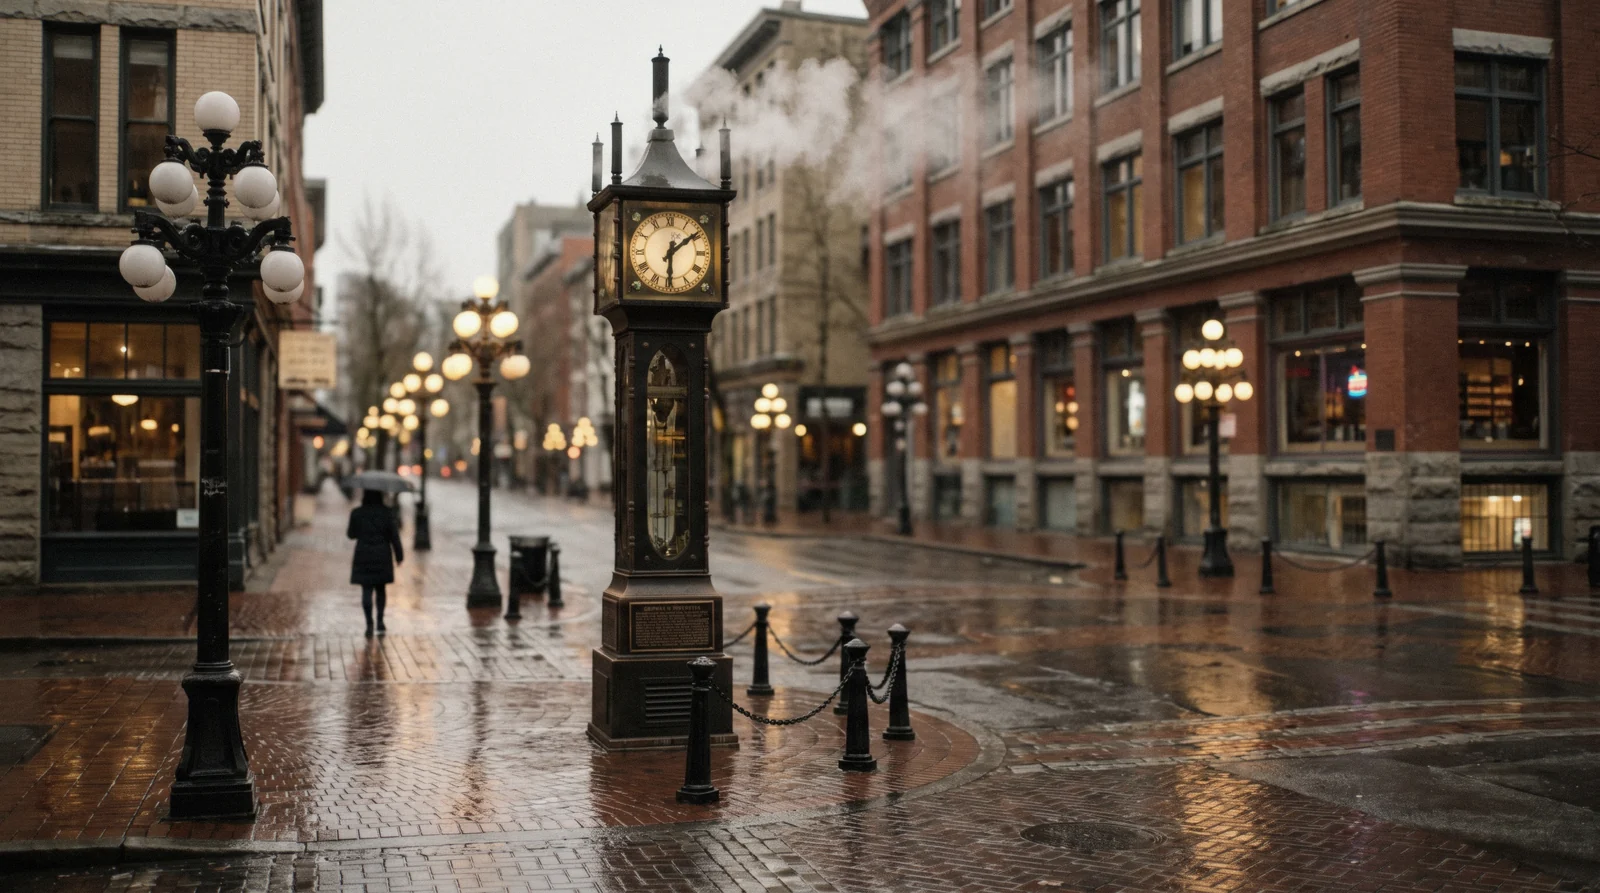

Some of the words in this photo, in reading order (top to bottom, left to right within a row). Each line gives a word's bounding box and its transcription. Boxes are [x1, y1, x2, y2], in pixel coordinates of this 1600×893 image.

[651, 220, 660, 230] XI
[666, 217, 674, 226] XII
[682, 220, 689, 230] I
[640, 232, 648, 240] X
[682, 276, 689, 285] V
